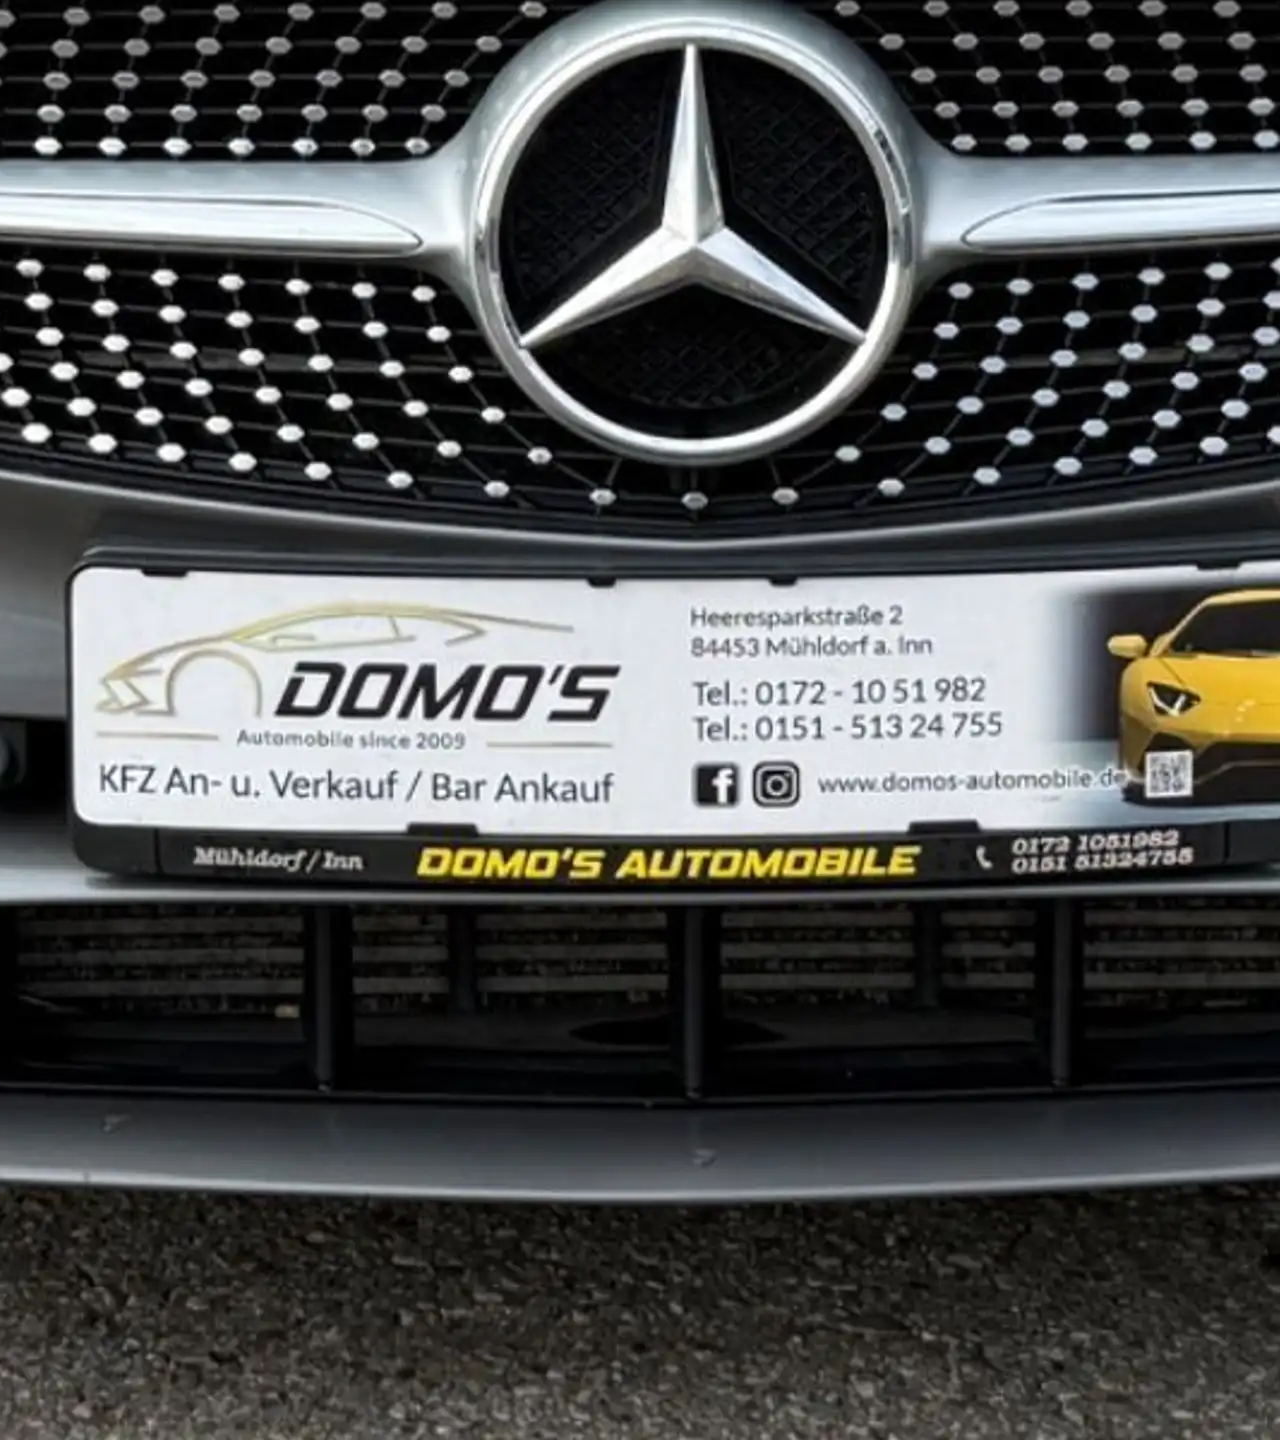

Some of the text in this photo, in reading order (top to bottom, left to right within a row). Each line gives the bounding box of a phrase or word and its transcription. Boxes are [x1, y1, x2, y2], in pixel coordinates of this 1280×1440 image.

[690, 604, 904, 630] Heeresparkstraße 2
[691, 634, 933, 658] 84453 Mühldorf a. Inn
[274, 661, 621, 722] DOMO'S
[693, 680, 748, 707] Tel.:
[754, 679, 826, 706] 0172
[852, 678, 887, 704] 10
[893, 678, 927, 704] 51
[934, 675, 987, 702] 982
[237, 729, 466, 750] Automobile since 2009
[693, 715, 748, 742] Tel.:
[754, 715, 826, 741] 0151
[850, 713, 903, 740] 513
[909, 713, 944, 739] 24
[952, 710, 1002, 737] 755
[99, 764, 156, 793] KFZ
[164, 766, 222, 797] An-
[231, 774, 261, 797] u.
[269, 769, 399, 802] Verkauf
[432, 773, 488, 802] Bar
[493, 772, 614, 803] Ankauf
[1011, 829, 1180, 856] 0172 1051982
[416, 844, 922, 880] DOMO'S AUTOMOBILE
[1011, 855, 1067, 874] 0151
